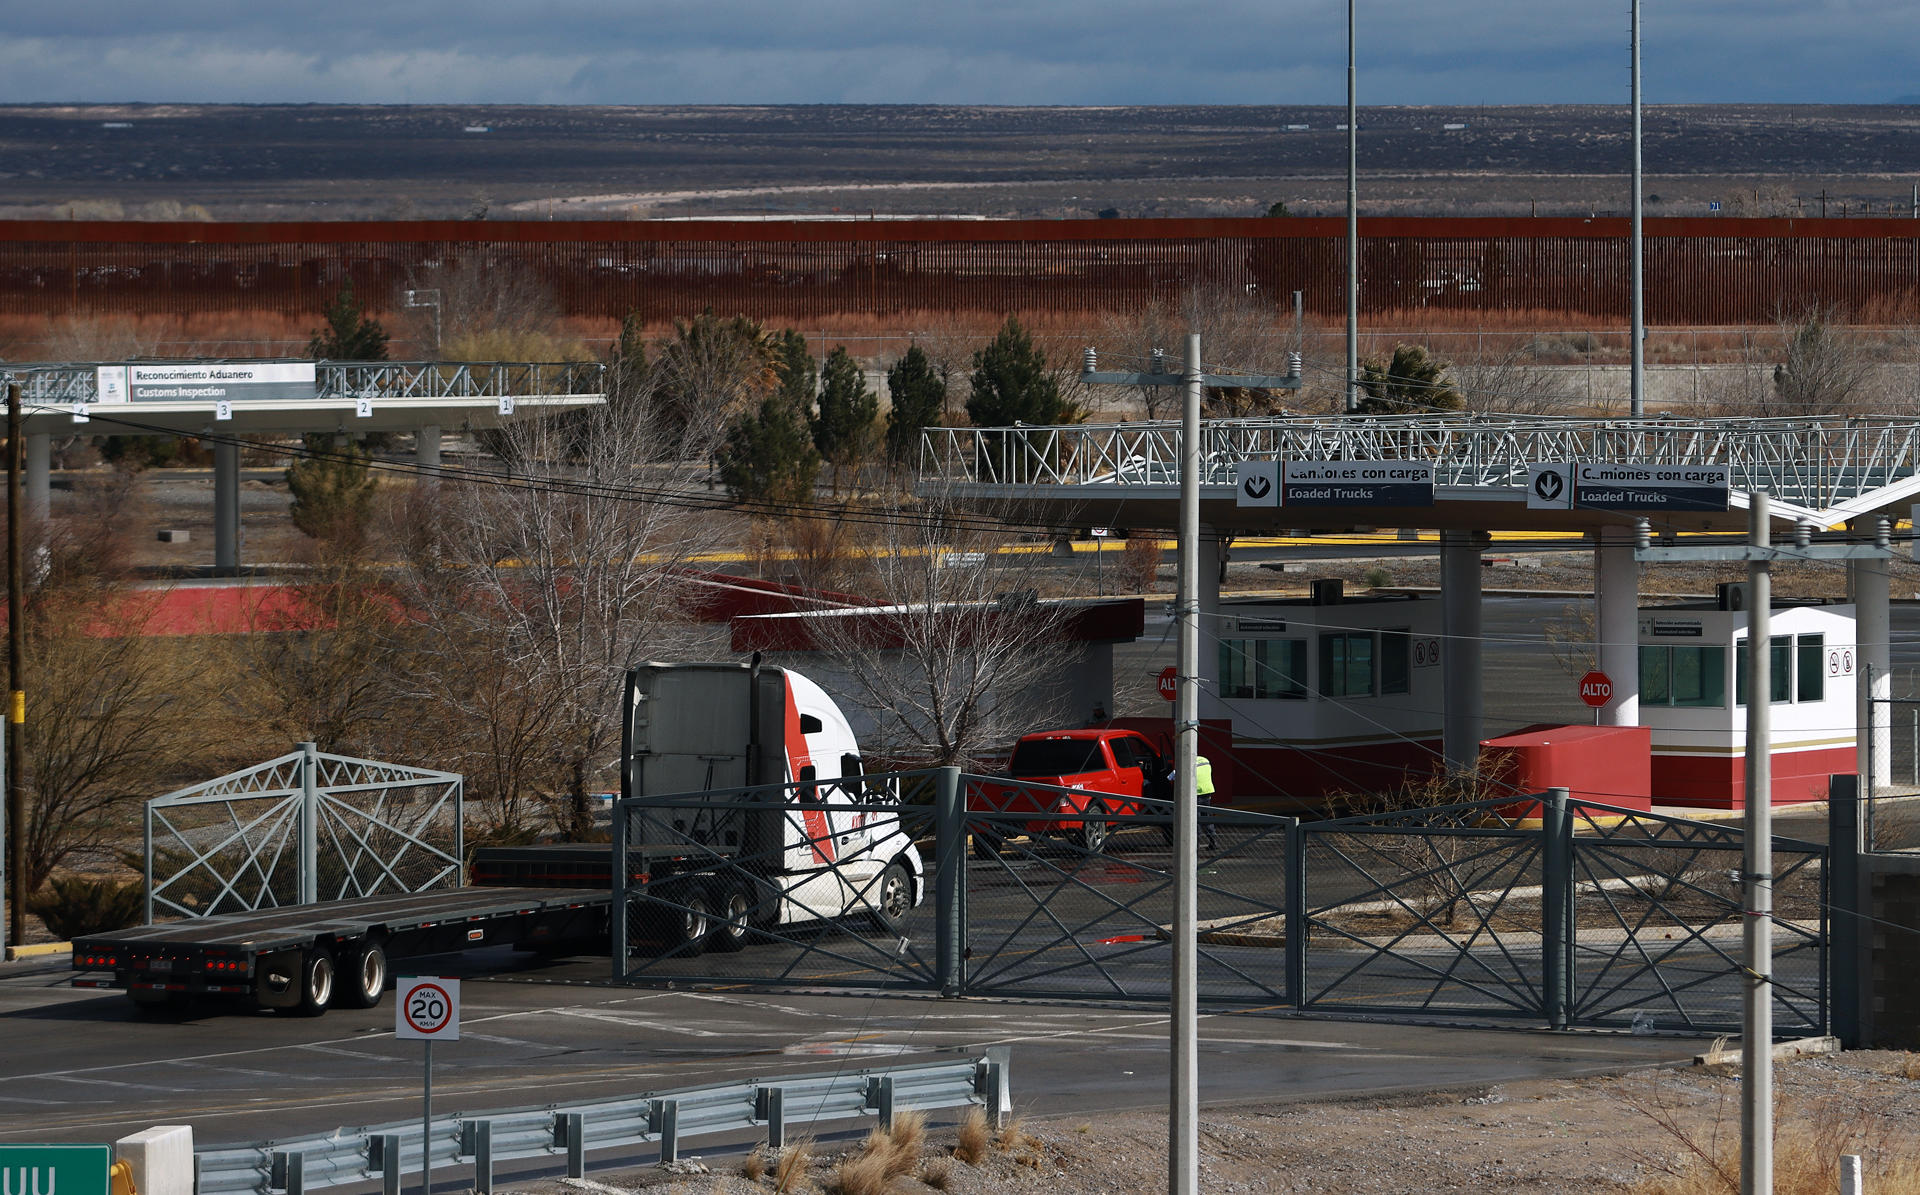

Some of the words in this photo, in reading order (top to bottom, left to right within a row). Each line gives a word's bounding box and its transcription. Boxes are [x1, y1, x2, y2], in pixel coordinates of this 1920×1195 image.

[136, 370, 207, 380] Reconocimiento
[209, 370, 253, 379] Aduanero
[136, 387, 177, 398] Customs
[178, 386, 226, 398] Inspection
[221, 404, 228, 415] 3
[361, 402, 367, 413] 2
[503, 400, 509, 411] 1
[1362, 469, 1386, 479] con
[1390, 469, 1429, 481] carga
[1582, 466, 1650, 480] Cmiones
[1656, 470, 1681, 480] con
[1685, 471, 1724, 484] carga
[1289, 488, 1331, 499] Loaded
[1334, 488, 1374, 499] Trucks
[1581, 491, 1624, 502] Loaded
[1627, 491, 1667, 503] Trucks
[1160, 678, 1177, 691] ALT
[1582, 683, 1611, 697] ALTO
[412, 999, 443, 1019] 20
